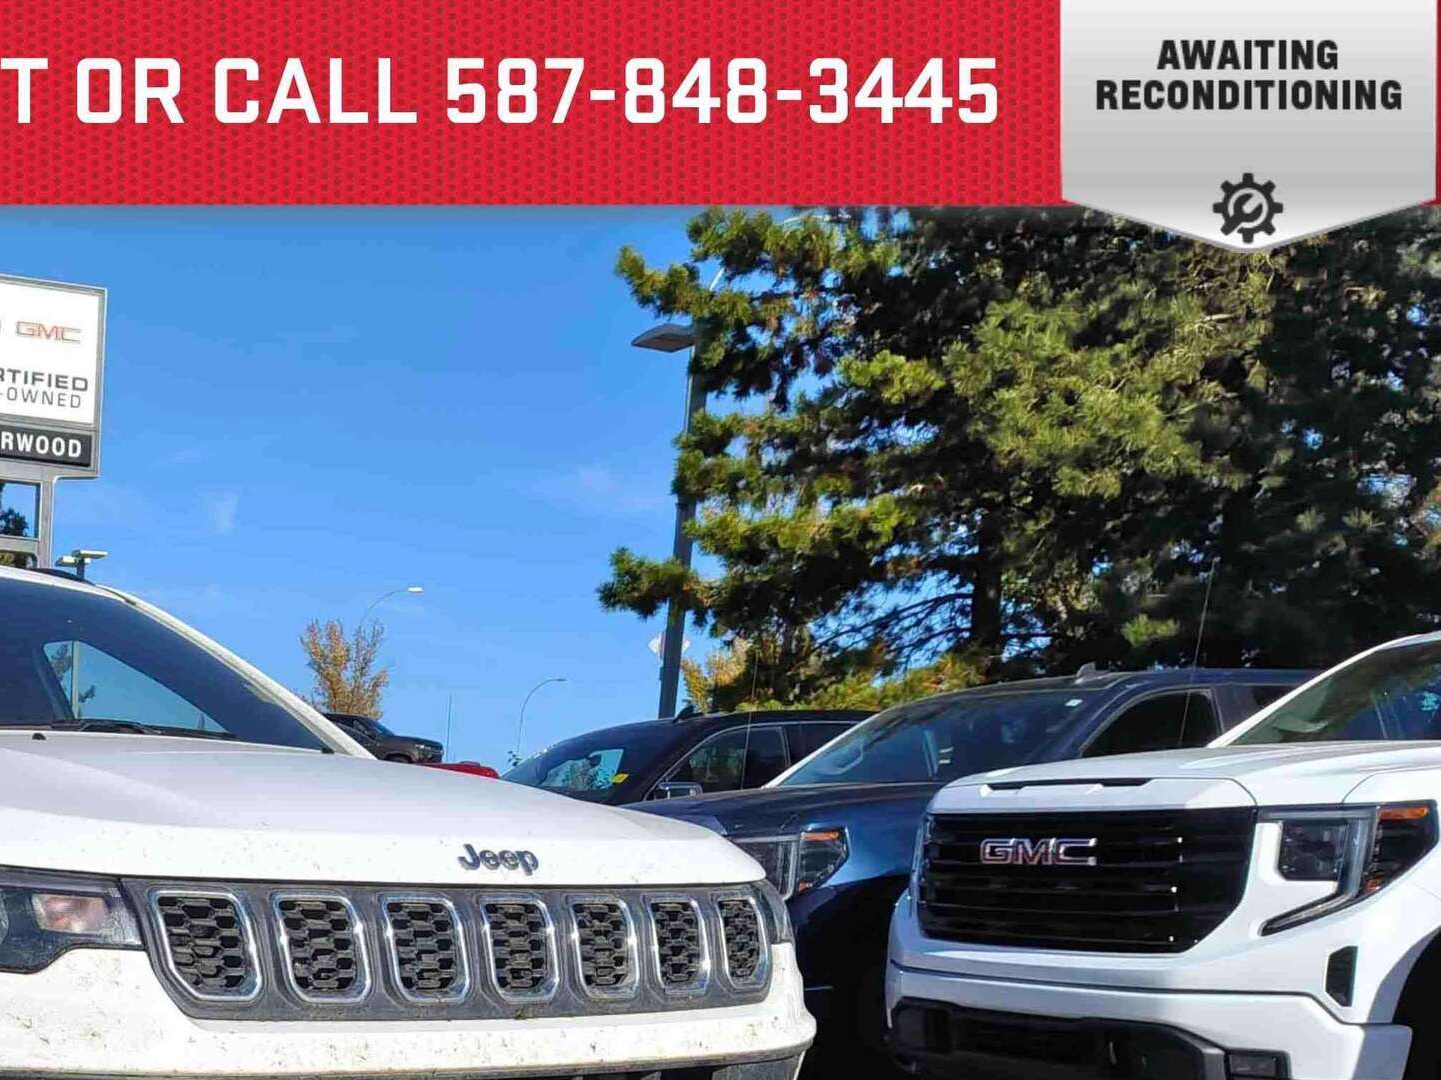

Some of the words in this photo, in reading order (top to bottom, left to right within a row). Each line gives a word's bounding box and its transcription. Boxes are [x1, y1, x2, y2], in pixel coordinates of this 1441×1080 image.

[15, 321, 81, 344] GMC
[457, 843, 539, 876] Jeep
[980, 837, 1097, 865] GMC
